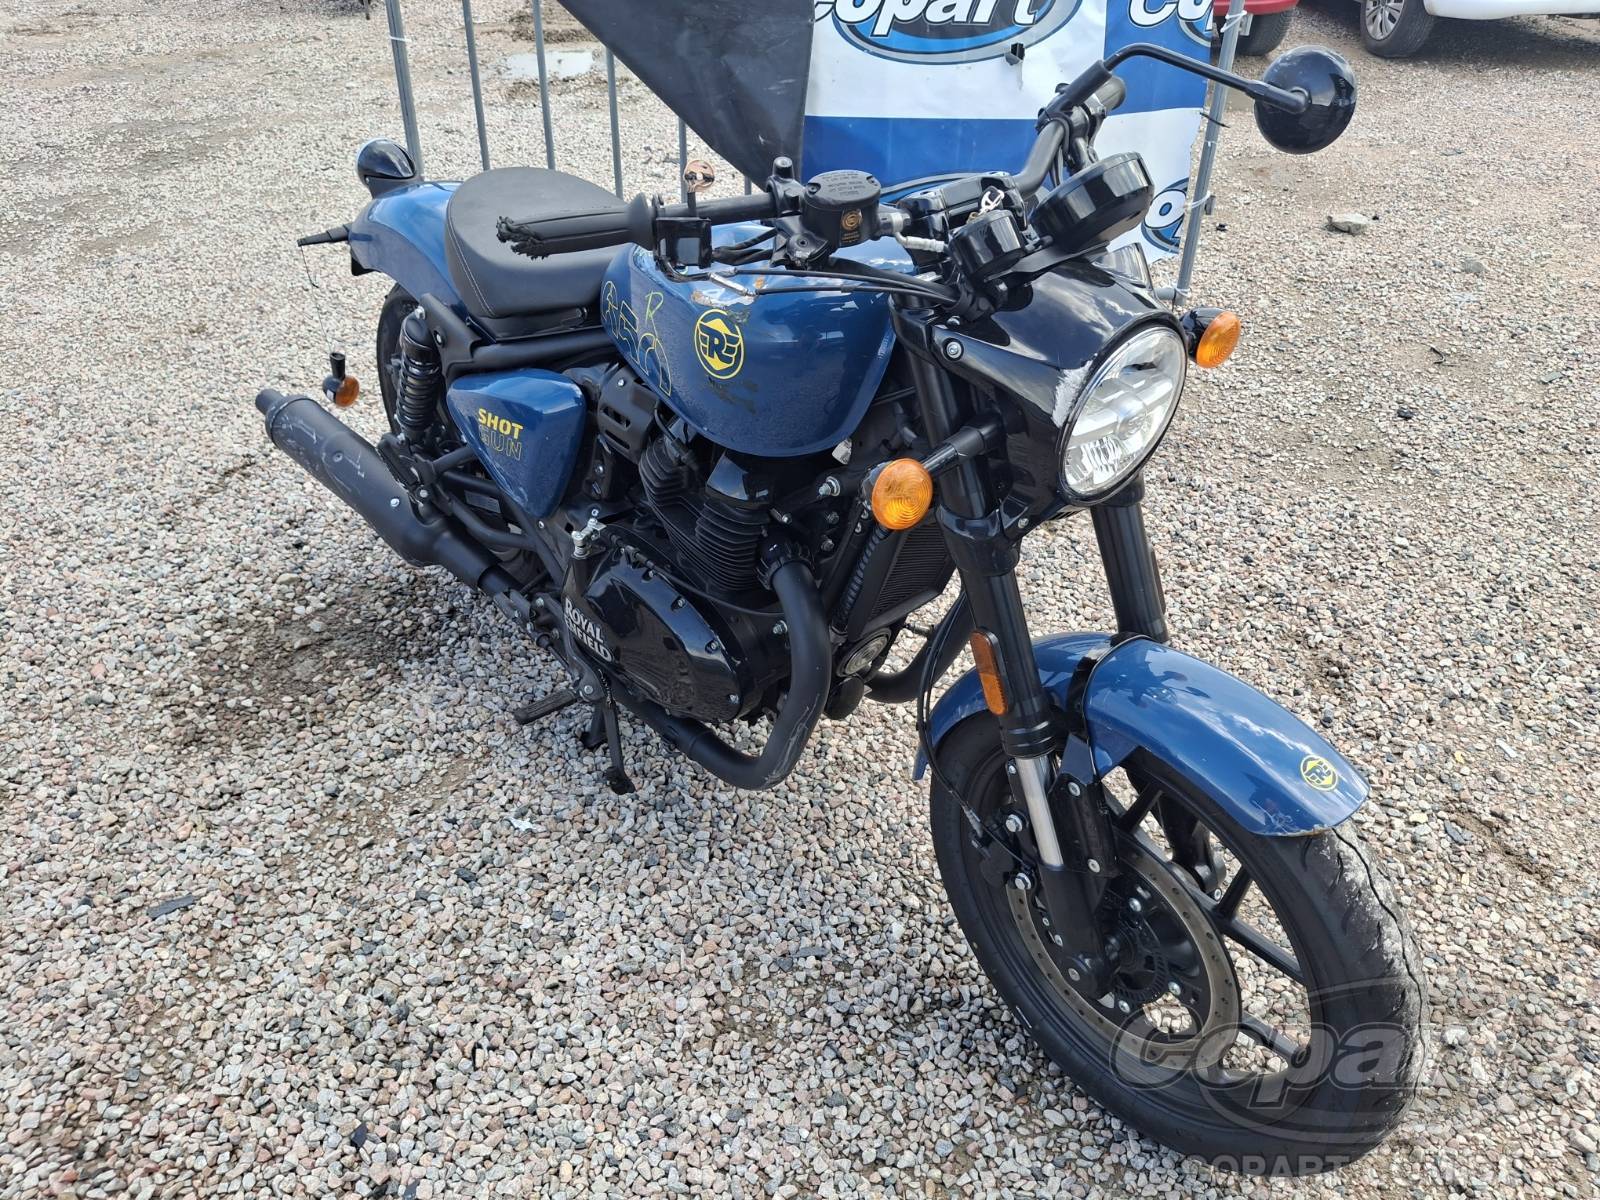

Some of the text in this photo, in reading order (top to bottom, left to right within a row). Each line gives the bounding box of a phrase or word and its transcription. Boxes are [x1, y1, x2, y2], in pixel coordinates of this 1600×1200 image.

[478, 408, 524, 440] SHOT
[479, 424, 522, 461] GUN
[564, 597, 604, 644] ROYAL
[564, 613, 612, 662] ENFIELD
